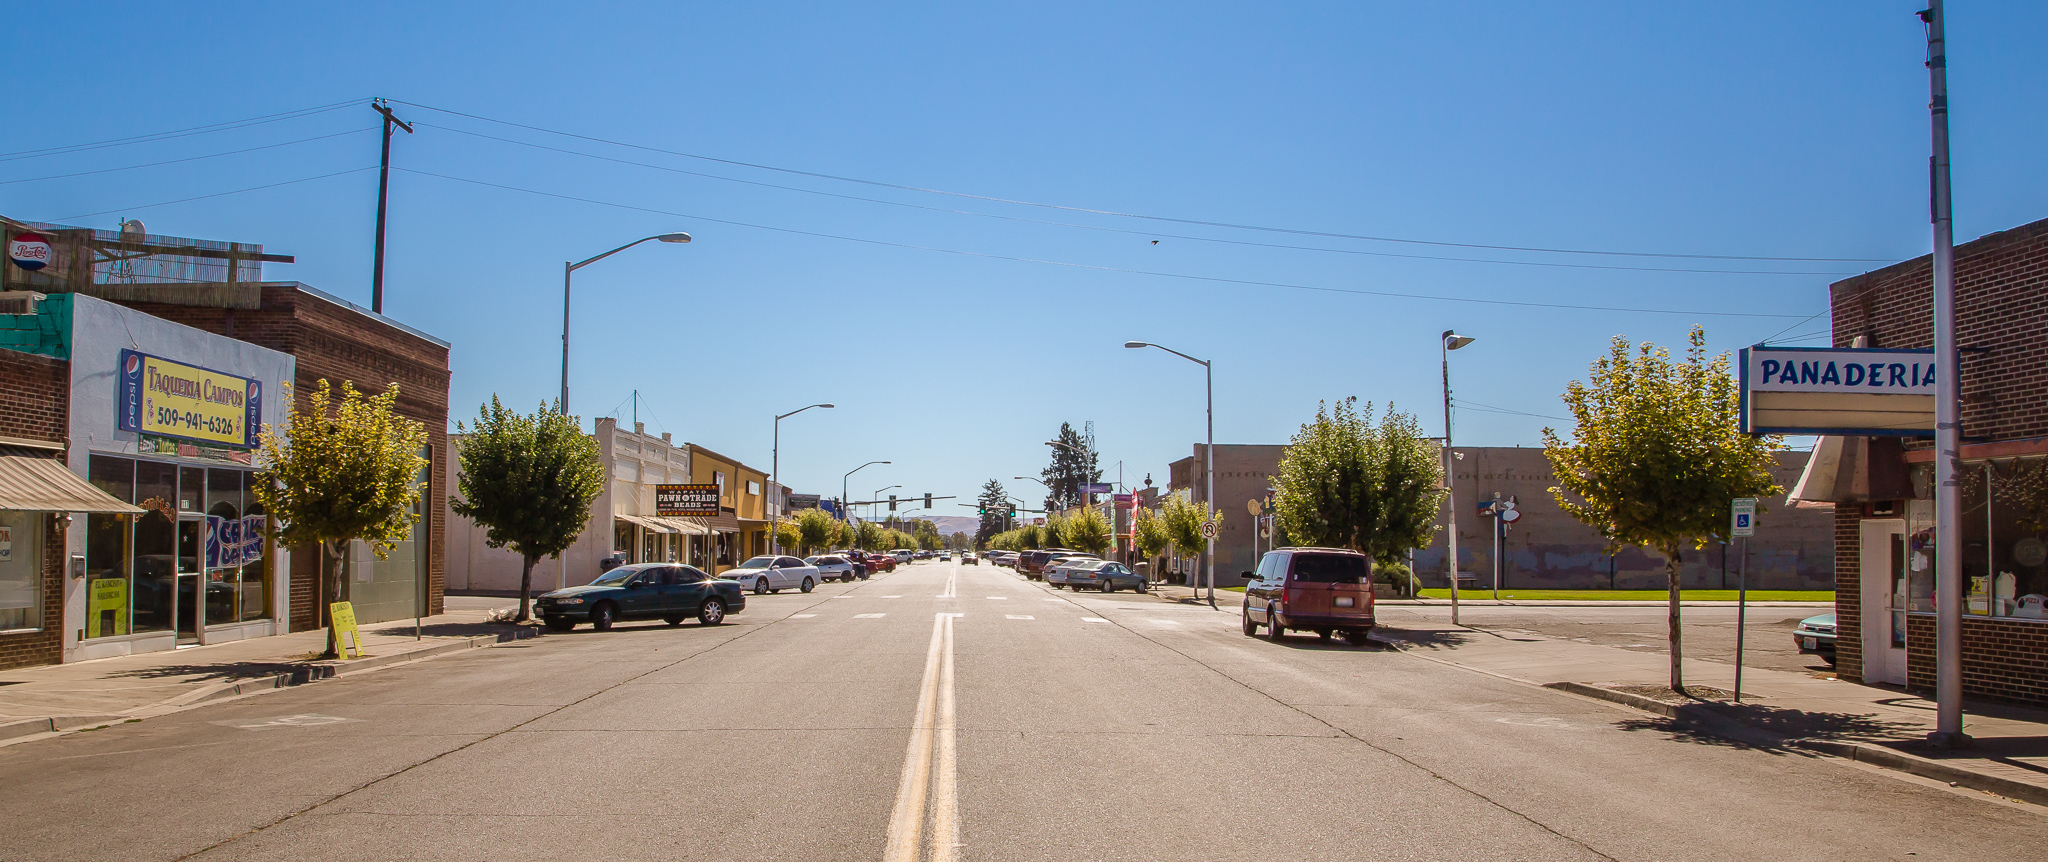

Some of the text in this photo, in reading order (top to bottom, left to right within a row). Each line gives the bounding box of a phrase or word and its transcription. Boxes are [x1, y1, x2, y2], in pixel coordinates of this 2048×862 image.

[147, 365, 244, 409] TAQUERIA CAMPOS
[1761, 359, 1936, 388] PANADERIA
[128, 381, 137, 428] pepsi
[157, 406, 234, 436] 509-941-6326
[249, 406, 257, 446] pepsi
[658, 494, 682, 502] PAWN
[689, 494, 717, 502] TRADE
